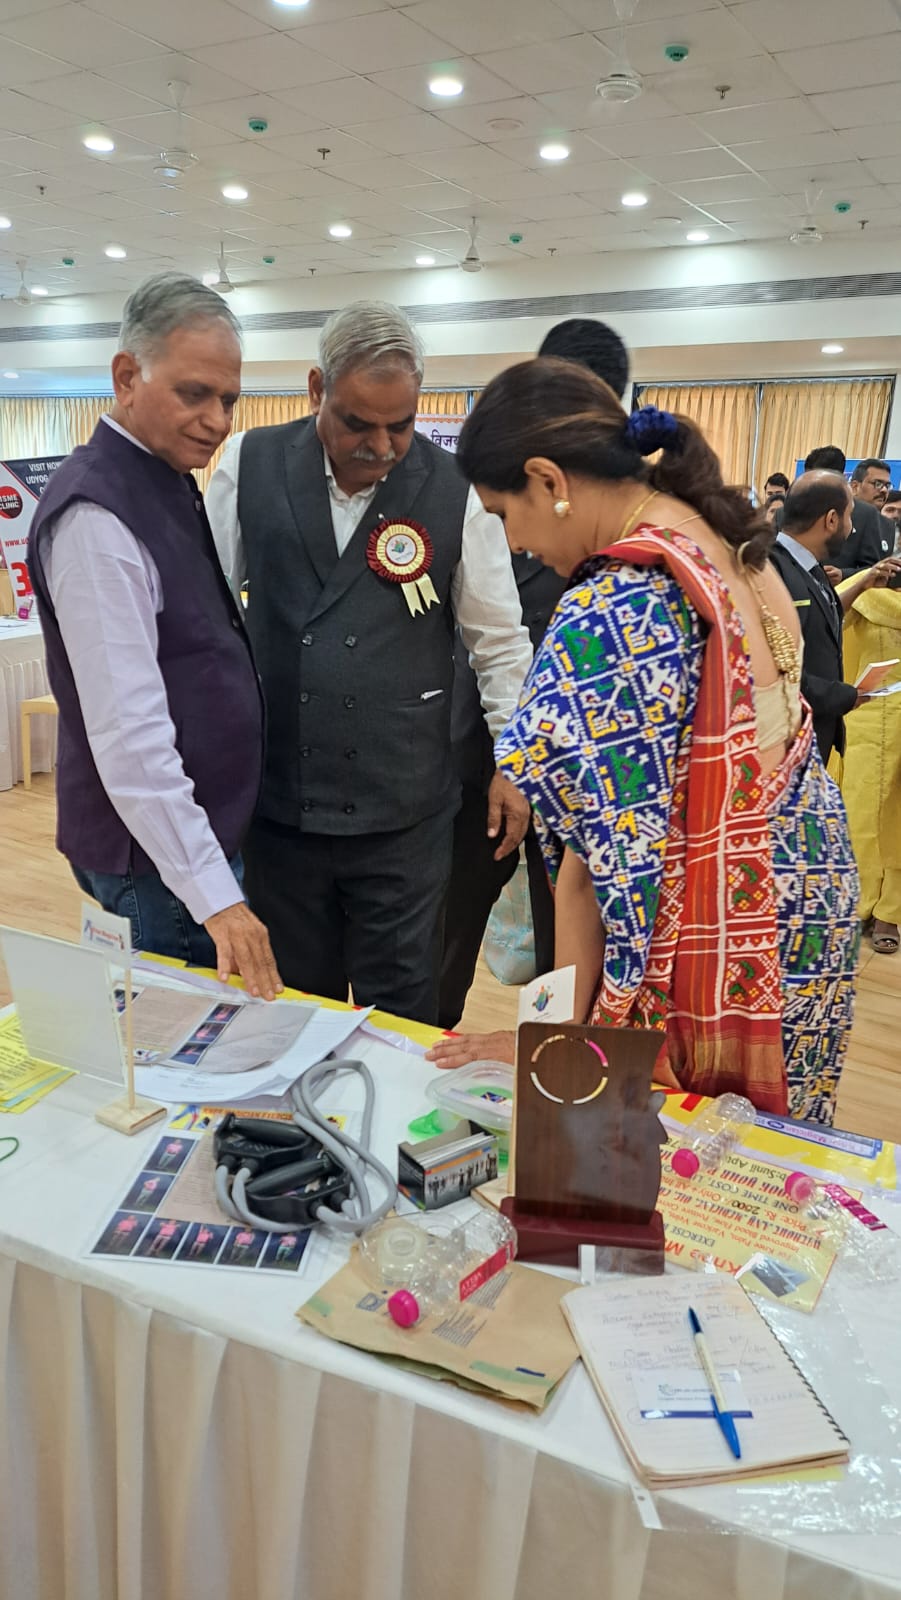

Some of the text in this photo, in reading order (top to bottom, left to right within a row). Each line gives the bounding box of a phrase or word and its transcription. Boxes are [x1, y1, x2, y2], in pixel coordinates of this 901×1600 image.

[28, 463, 46, 471] VISIT
[26, 474, 49, 484] UDYOG
[701, 1188, 721, 1202] Only
[742, 1189, 769, 1204] TIME
[774, 1200, 799, 1214] ONE
[671, 1225, 716, 1247] EXERCISE
[734, 1224, 758, 1239] Blood
[753, 1241, 775, 1255] Knee
[760, 1233, 800, 1252] Improved
